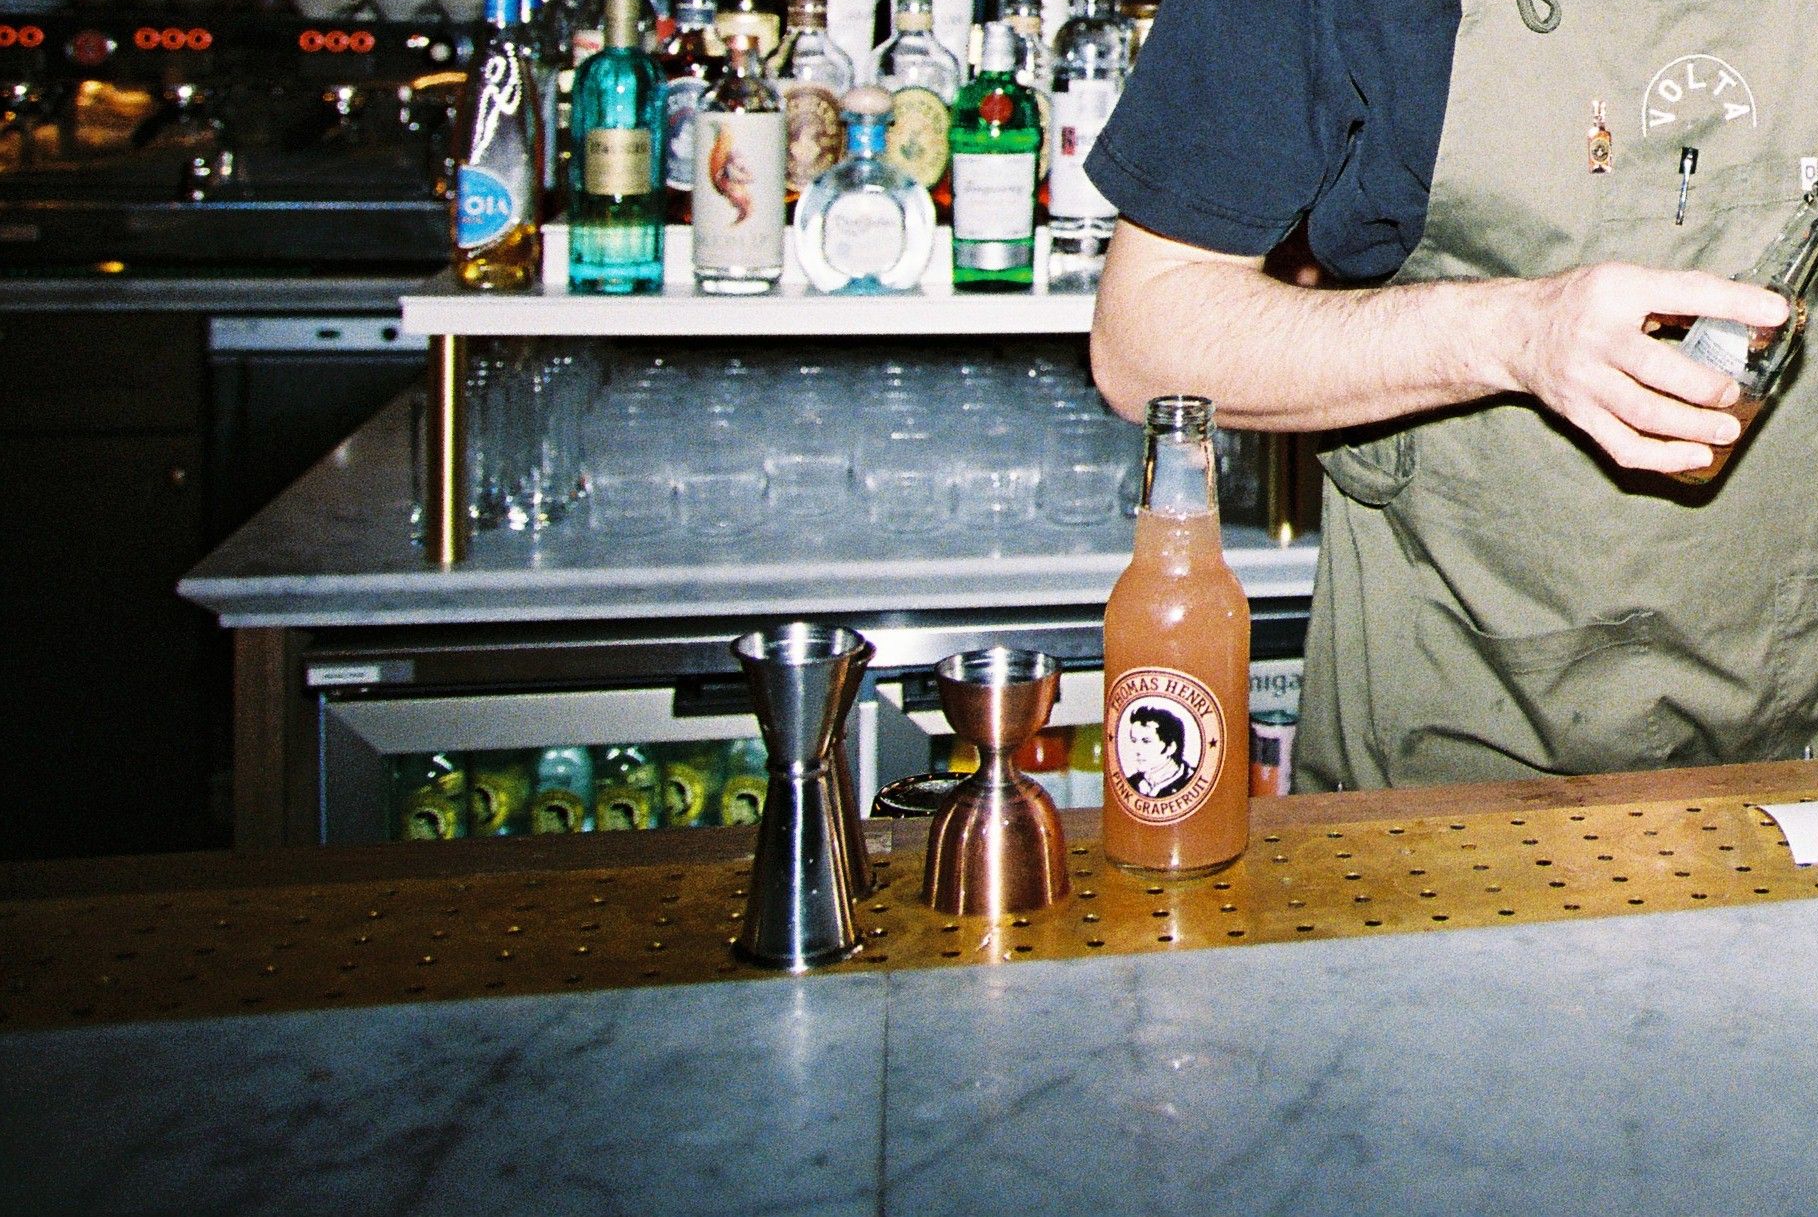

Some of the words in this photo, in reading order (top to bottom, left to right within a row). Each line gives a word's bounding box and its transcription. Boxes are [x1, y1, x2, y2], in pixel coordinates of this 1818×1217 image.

[1648, 63, 1751, 128] VOLTA
[1111, 677, 1159, 712] THOMAS
[1165, 679, 1213, 719] HENRY
[1112, 771, 1134, 804] PINK
[1134, 775, 1209, 815] GRAPEFRUIT
